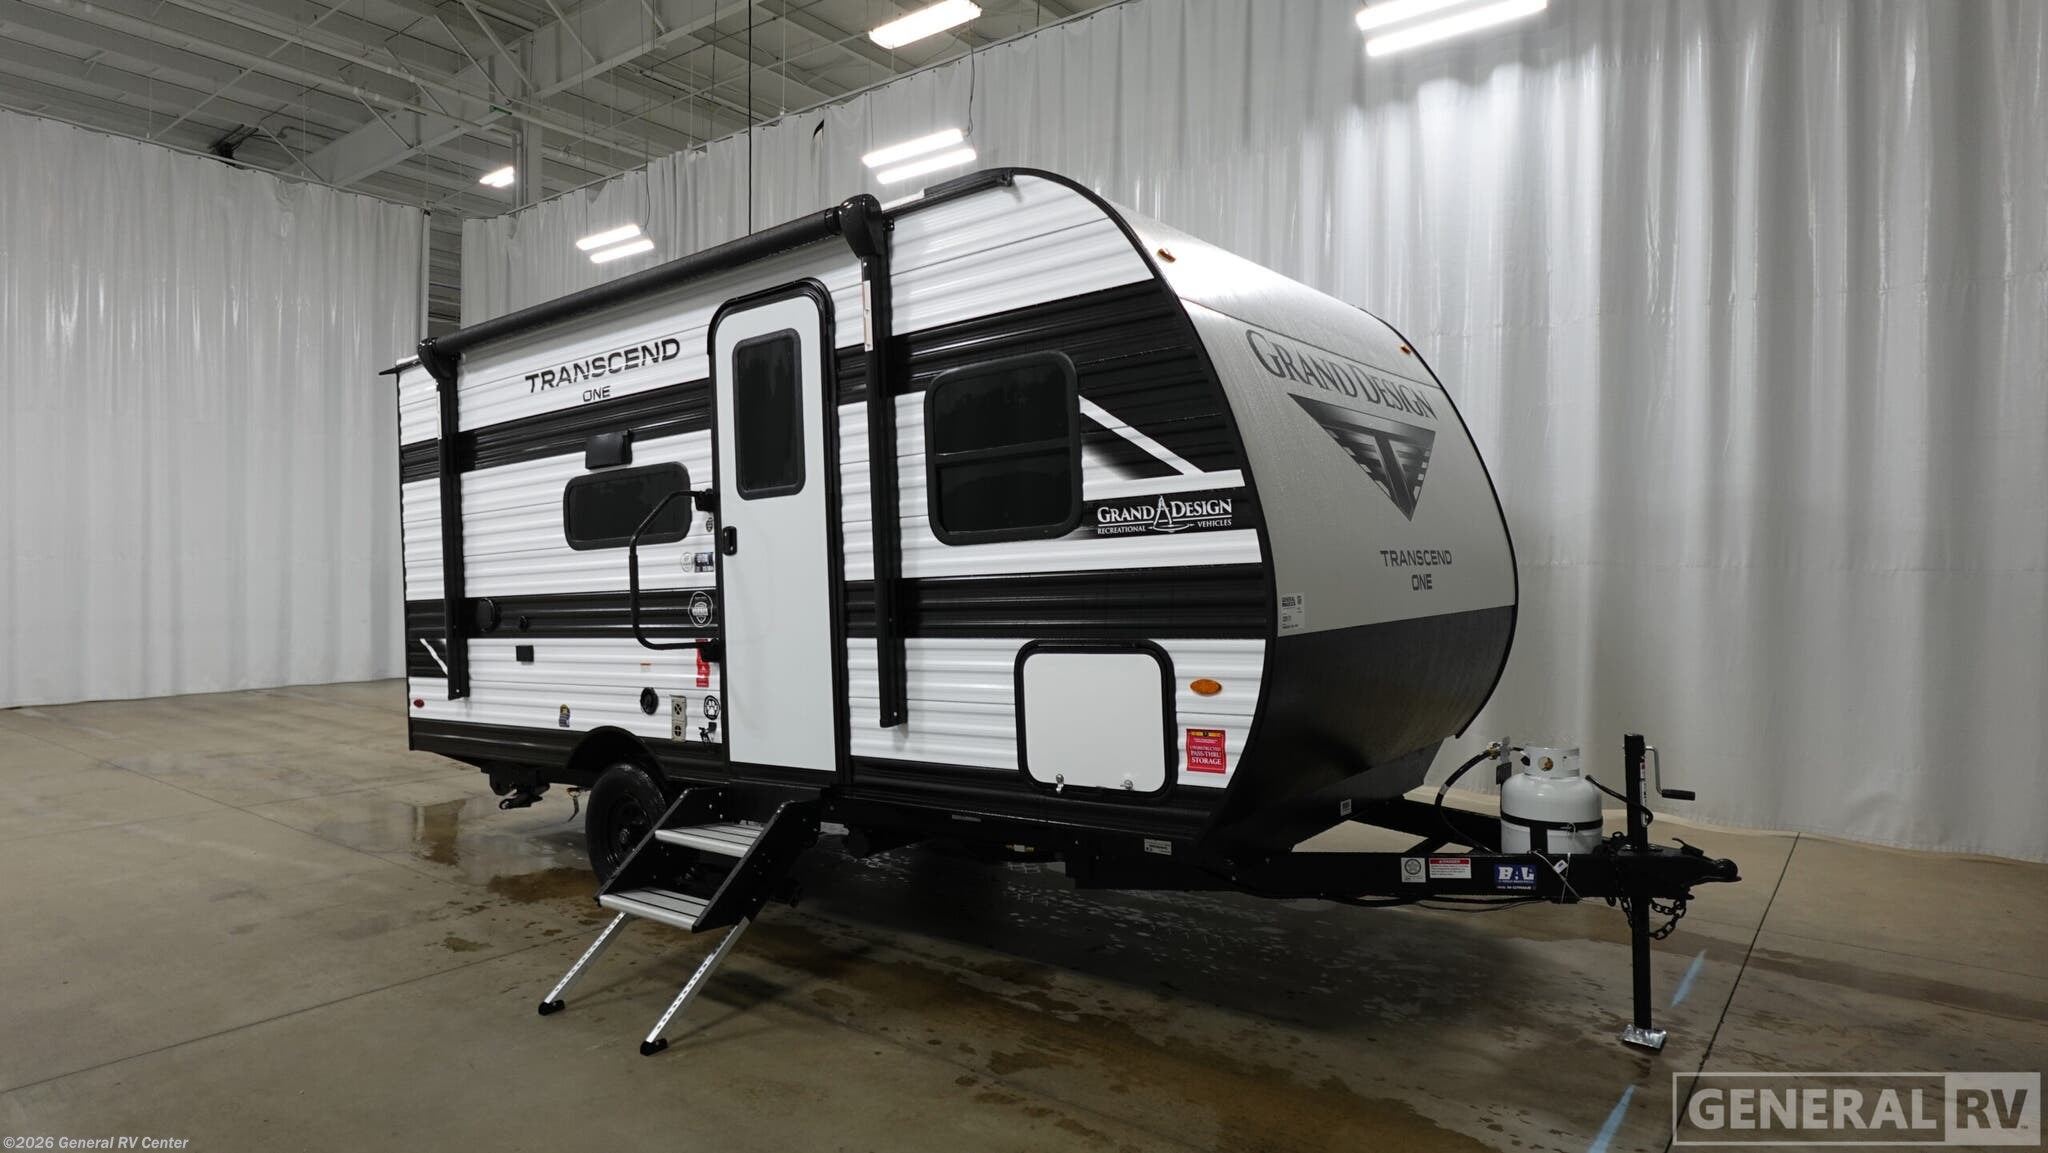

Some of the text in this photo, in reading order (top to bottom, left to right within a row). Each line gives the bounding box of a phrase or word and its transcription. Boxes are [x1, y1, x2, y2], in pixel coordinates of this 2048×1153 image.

[525, 338, 681, 393] TRANSCEND
[1245, 329, 1439, 421] GRAND DESIGN
[582, 385, 612, 402] ONE
[1097, 499, 1232, 523] GRAND DESIGN
[1097, 519, 1232, 535] RECREATIONAL VEHICLES
[1380, 550, 1452, 567] TRANSCEND
[1411, 573, 1433, 591] ONE
